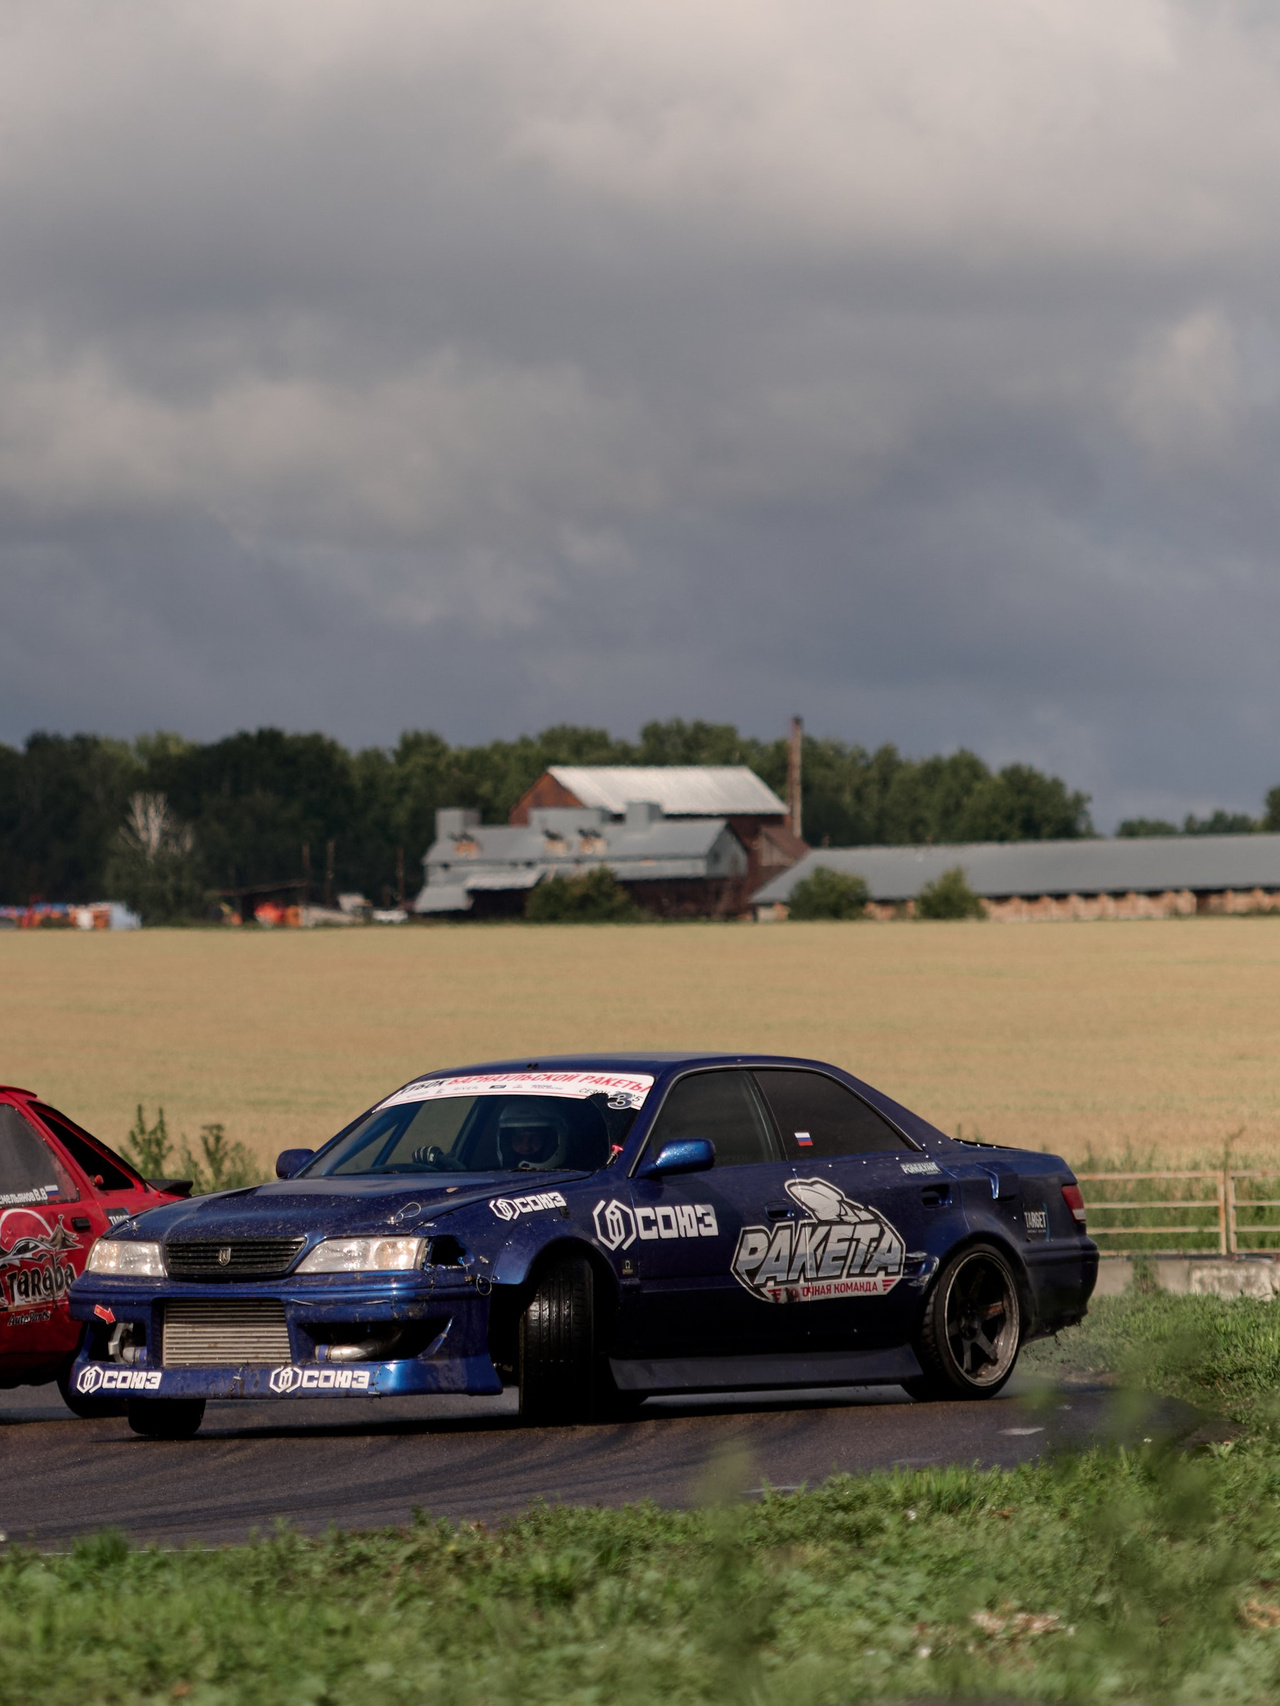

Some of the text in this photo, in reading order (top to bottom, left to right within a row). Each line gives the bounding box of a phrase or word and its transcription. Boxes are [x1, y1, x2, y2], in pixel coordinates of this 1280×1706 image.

[513, 1192, 566, 1213] СОЮЗ
[634, 1204, 719, 1240] СОЮЗ
[734, 1222, 903, 1287] РАКЕТА
[834, 1281, 878, 1294] КОМАНДА
[102, 1370, 162, 1389] СОЮЗ
[302, 1370, 370, 1389] СОЮЗ
